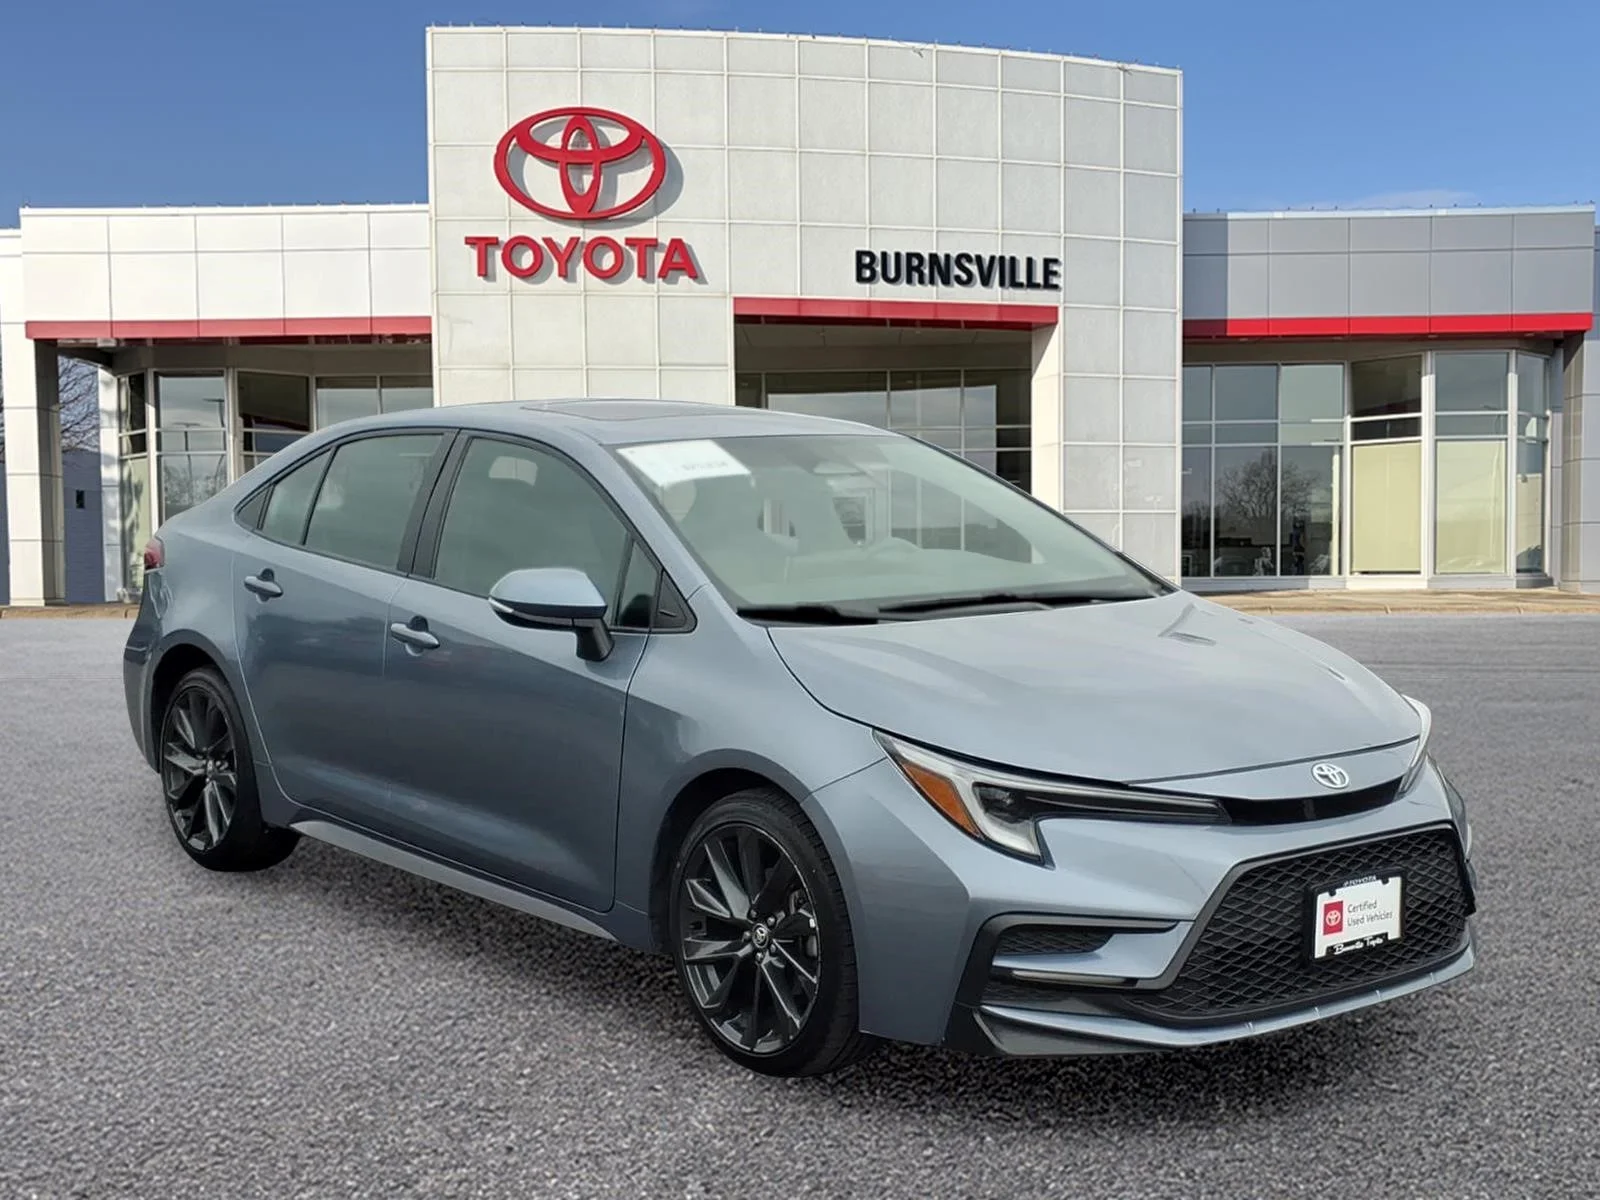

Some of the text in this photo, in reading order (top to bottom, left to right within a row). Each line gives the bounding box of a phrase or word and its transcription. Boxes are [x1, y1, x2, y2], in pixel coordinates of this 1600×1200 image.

[465, 235, 699, 279] TOYOTA
[855, 249, 1060, 290] BURNSVILLE
[1347, 900, 1378, 914] Certified
[1347, 910, 1393, 928] Used Vehicles
